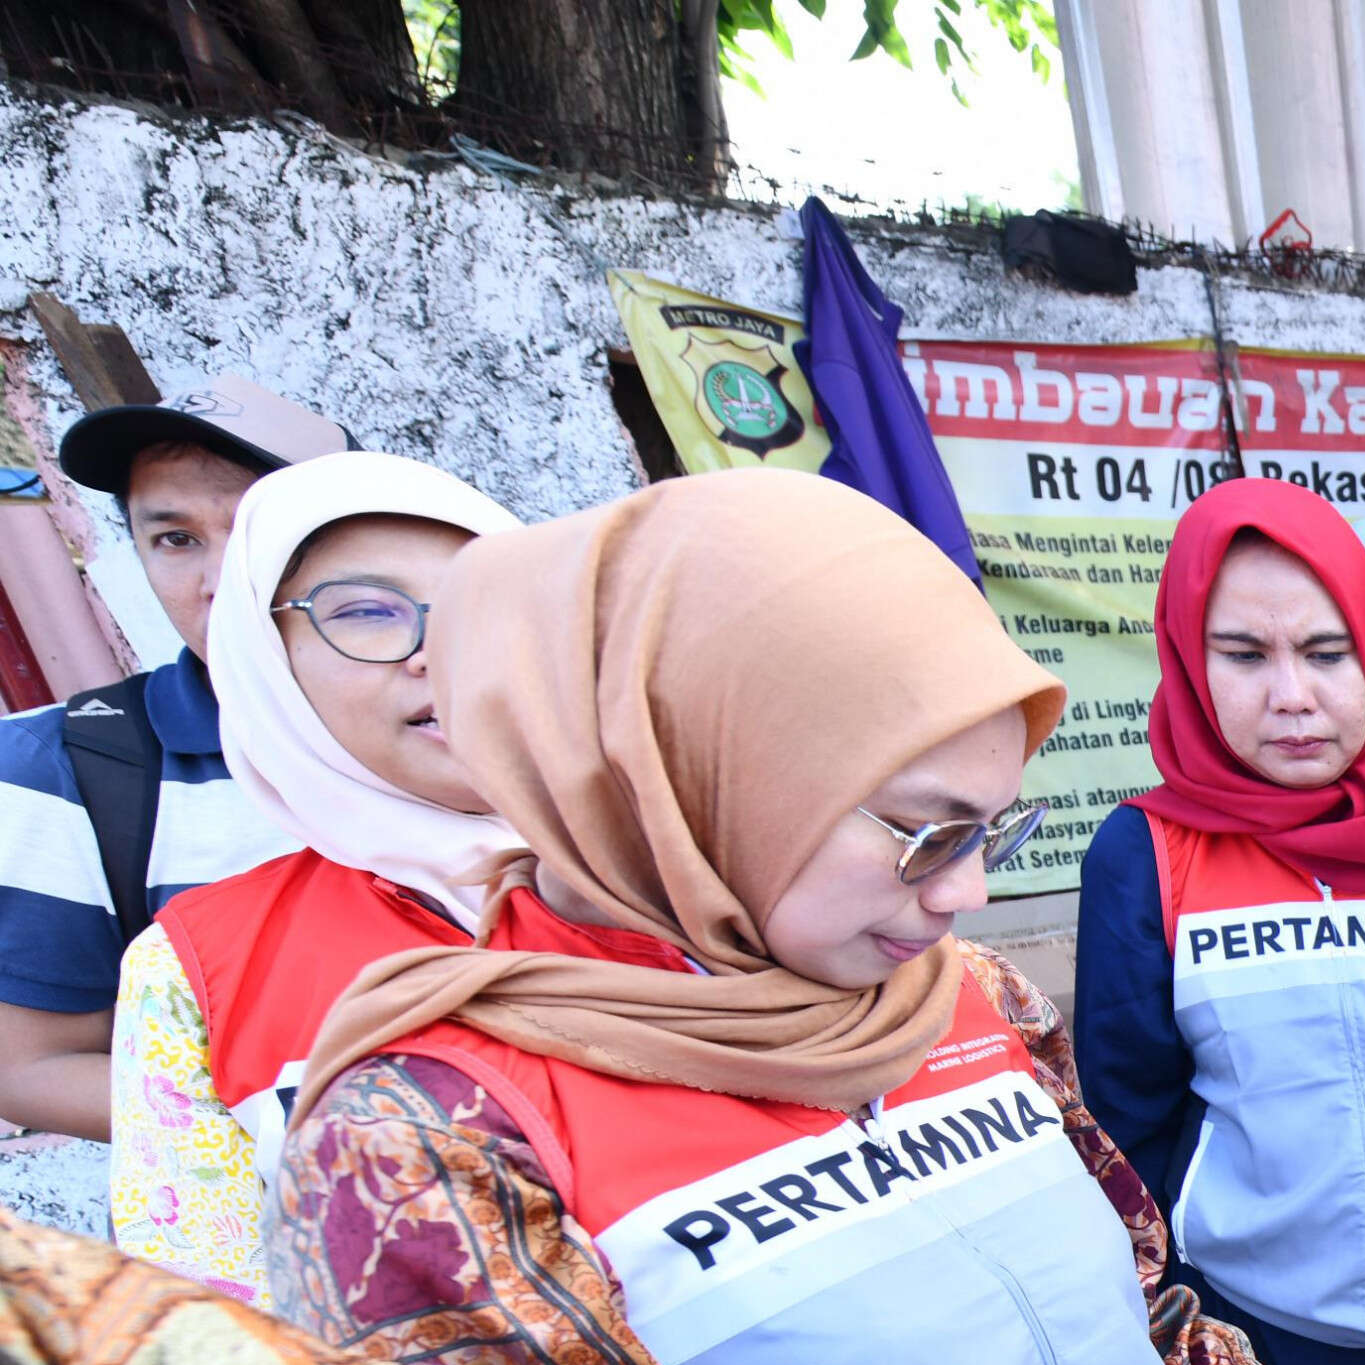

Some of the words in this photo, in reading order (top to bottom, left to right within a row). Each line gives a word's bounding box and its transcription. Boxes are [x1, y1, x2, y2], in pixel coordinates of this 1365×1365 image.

[670, 310, 731, 326] METRO
[735, 314, 776, 338] JAYA
[903, 342, 1278, 432] imbauan
[1027, 452, 1081, 501] Rt
[1095, 457, 1152, 502] 04
[1014, 532, 1117, 557] Mengintai
[977, 559, 1082, 581] Kendaraan
[1087, 564, 1127, 583] dan
[1129, 565, 1161, 583] Har
[1015, 615, 1110, 637] Keluarga
[1071, 702, 1090, 721] di
[1039, 732, 1113, 757] jahatan
[926, 1044, 961, 1059] OLDING
[662, 1089, 1061, 1272] PERTAMINA
